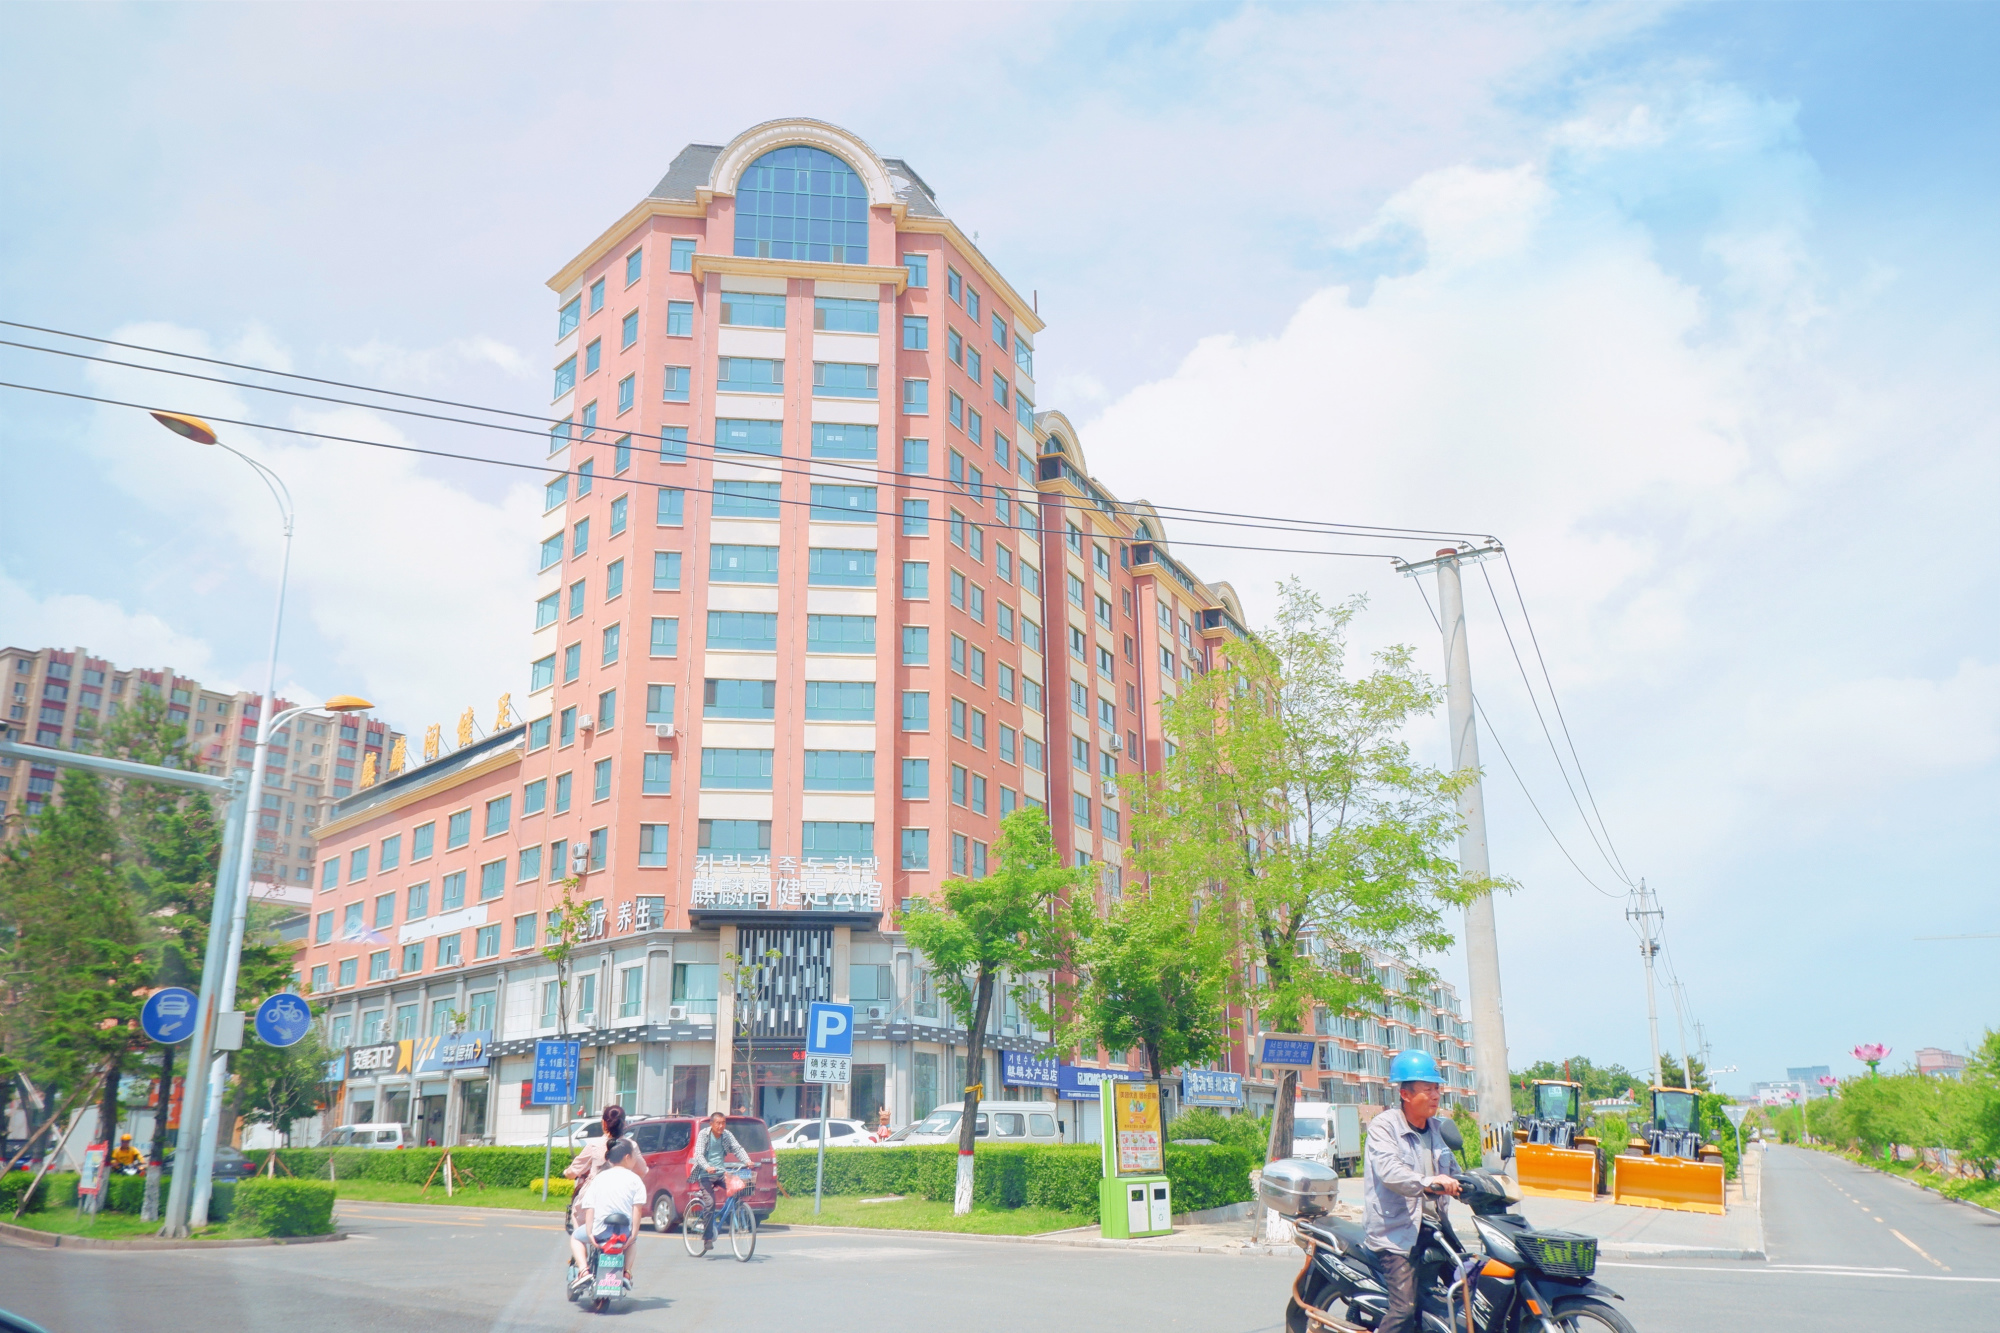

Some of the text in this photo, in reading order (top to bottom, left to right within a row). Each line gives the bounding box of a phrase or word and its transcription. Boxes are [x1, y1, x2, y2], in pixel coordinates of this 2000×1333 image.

[690, 877, 882, 907] 麒麟阁健足公馆
[617, 898, 651, 932] 养生
[816, 1010, 847, 1049] P
[809, 1069, 846, 1080] 停车入位
[810, 1058, 847, 1070] 确保安全
